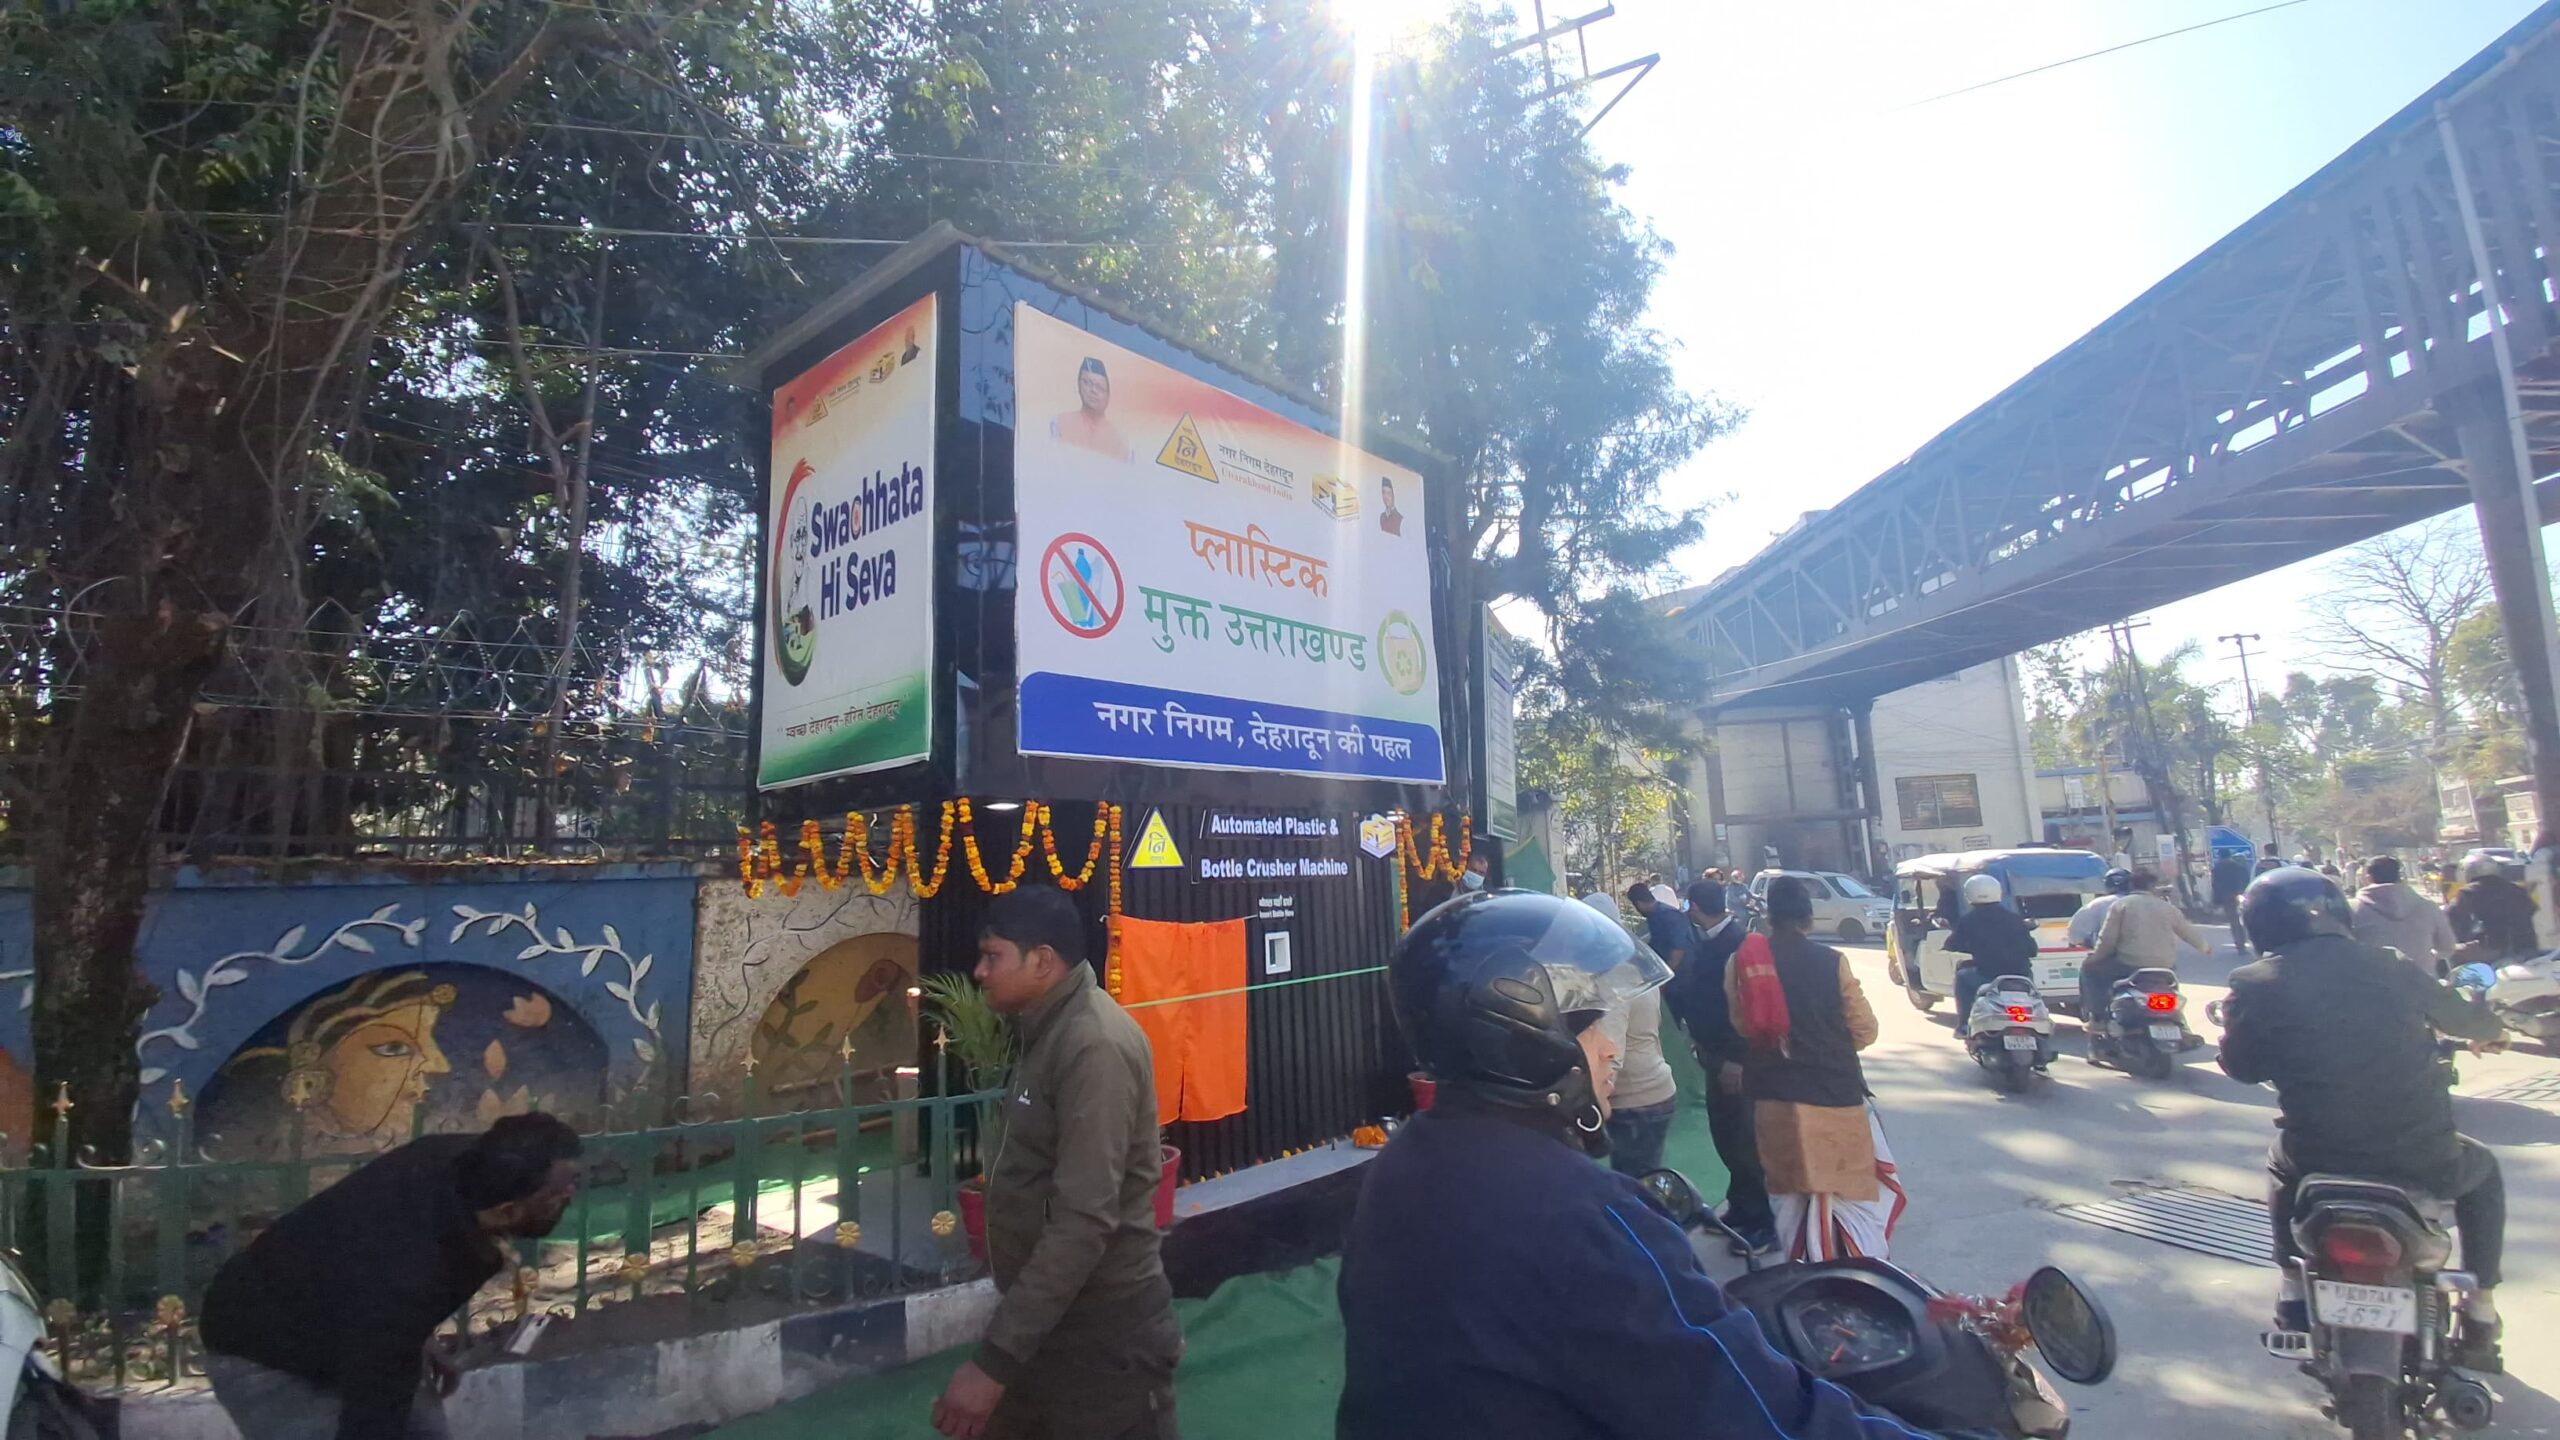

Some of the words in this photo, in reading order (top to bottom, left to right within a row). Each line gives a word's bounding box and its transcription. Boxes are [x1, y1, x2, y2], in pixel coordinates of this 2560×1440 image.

[1217, 443, 1237, 459] नगर
[1239, 449, 1262, 470] निगम
[1264, 458, 1294, 484] देहरादून
[810, 461, 923, 558] Swachhata
[821, 557, 841, 620] Hi
[846, 549, 896, 611] Seva
[1184, 520, 1328, 598] प्लास्टिक
[1138, 586, 1213, 653] मुक्त
[1219, 603, 1367, 671] उत्तराखण्ड
[1093, 701, 1157, 736] नगर
[1248, 711, 1331, 760] देहरादून
[1335, 724, 1366, 757] की
[1369, 732, 1411, 760] पहल
[1211, 814, 1283, 835] Automated
[1285, 817, 1327, 836] Plastic
[1329, 818, 1339, 836] &
[1201, 858, 1244, 878] Bottle
[1246, 858, 1297, 877] Crusher
[1300, 858, 1349, 877] Machine
